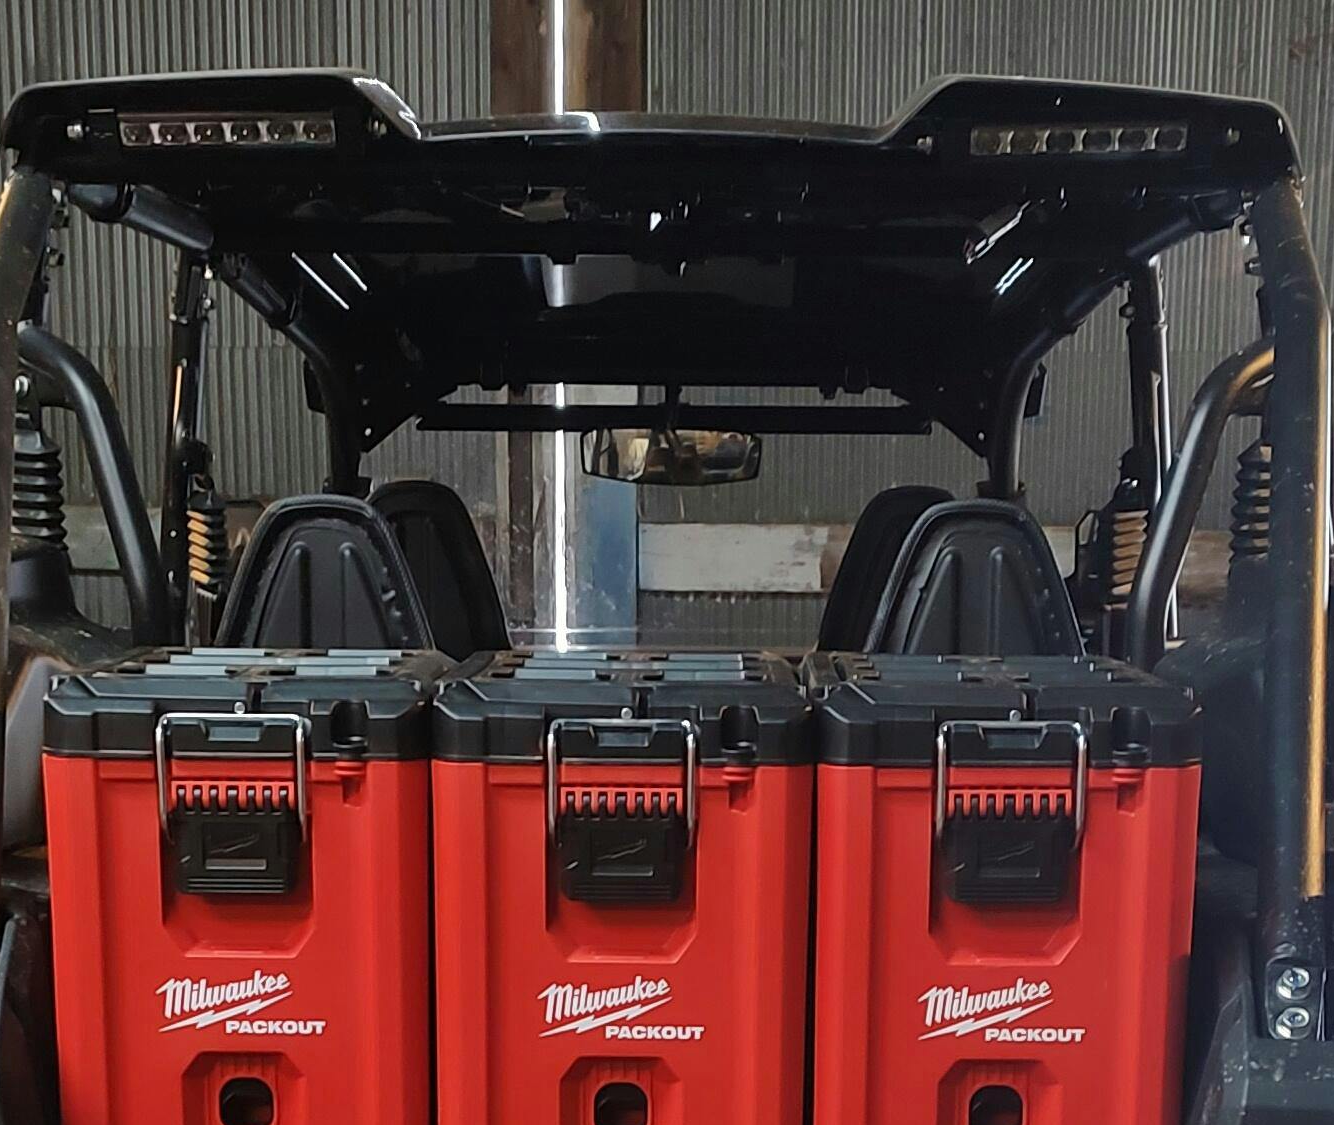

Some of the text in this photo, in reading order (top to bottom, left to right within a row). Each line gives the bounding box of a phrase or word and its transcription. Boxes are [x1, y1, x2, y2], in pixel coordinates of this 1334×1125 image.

[155, 970, 291, 1019] Milwaukee
[537, 976, 671, 1024] Milwaukee
[917, 978, 1052, 1027] Milwaukee
[225, 1020, 327, 1035] PACKOUT
[605, 1026, 705, 1041] PACKOUT
[985, 1028, 1086, 1043] PACKOUT
